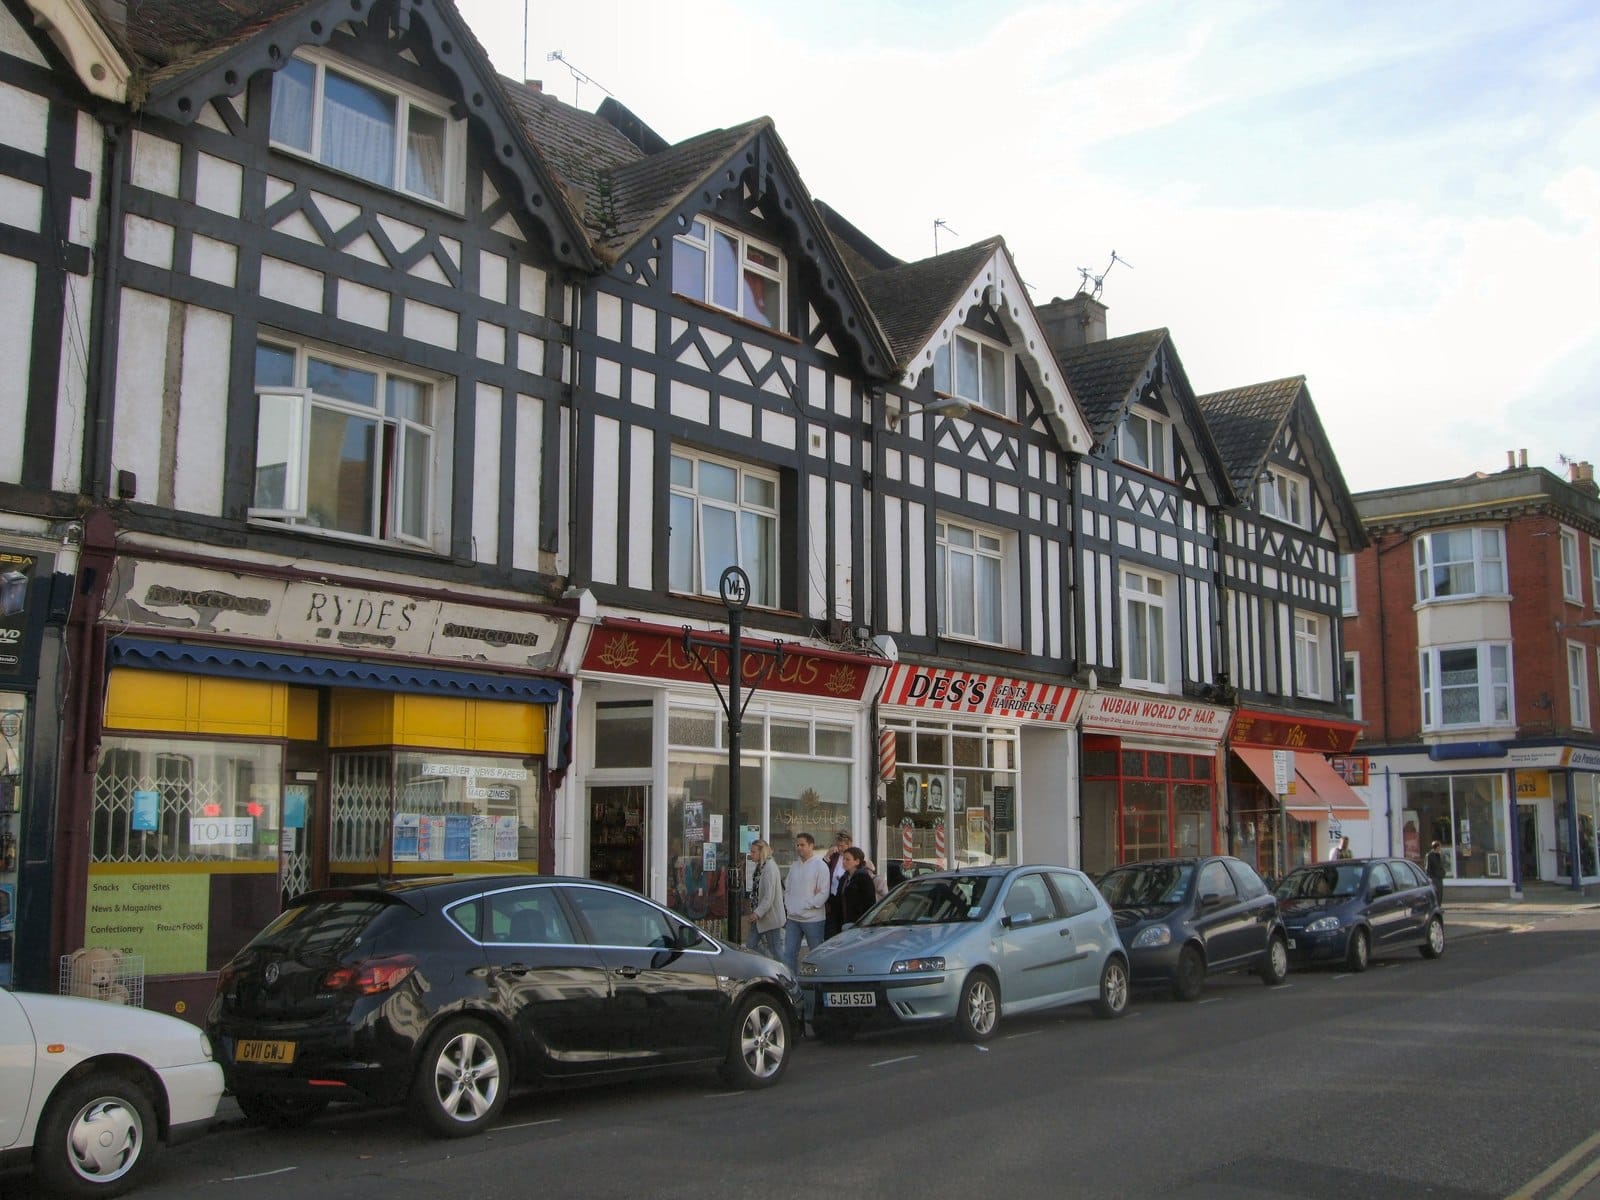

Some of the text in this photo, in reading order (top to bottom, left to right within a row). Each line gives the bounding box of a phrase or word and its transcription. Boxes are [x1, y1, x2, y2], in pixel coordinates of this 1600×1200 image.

[305, 593, 416, 632] RYDES
[650, 637, 822, 685] ASIA OTUS
[908, 674, 987, 705] DES'S
[994, 685, 1028, 698] GENTS
[991, 698, 1057, 714] HAIRDRESSER
[1100, 697, 1215, 724] NUBIAN WORLD OF HAIR
[423, 764, 525, 780] WE DELIVER NEWS PAPERS
[468, 788, 511, 799] MAGAZINES
[1517, 783, 1536, 792] ATS
[193, 823, 251, 841] TO LET
[93, 883, 170, 892] Snacks Cigarettes
[91, 904, 162, 914] News & Magazines
[91, 925, 144, 935] Confectionery
[182, 922, 204, 932] Foods
[830, 993, 873, 1005] GJ51 SZD
